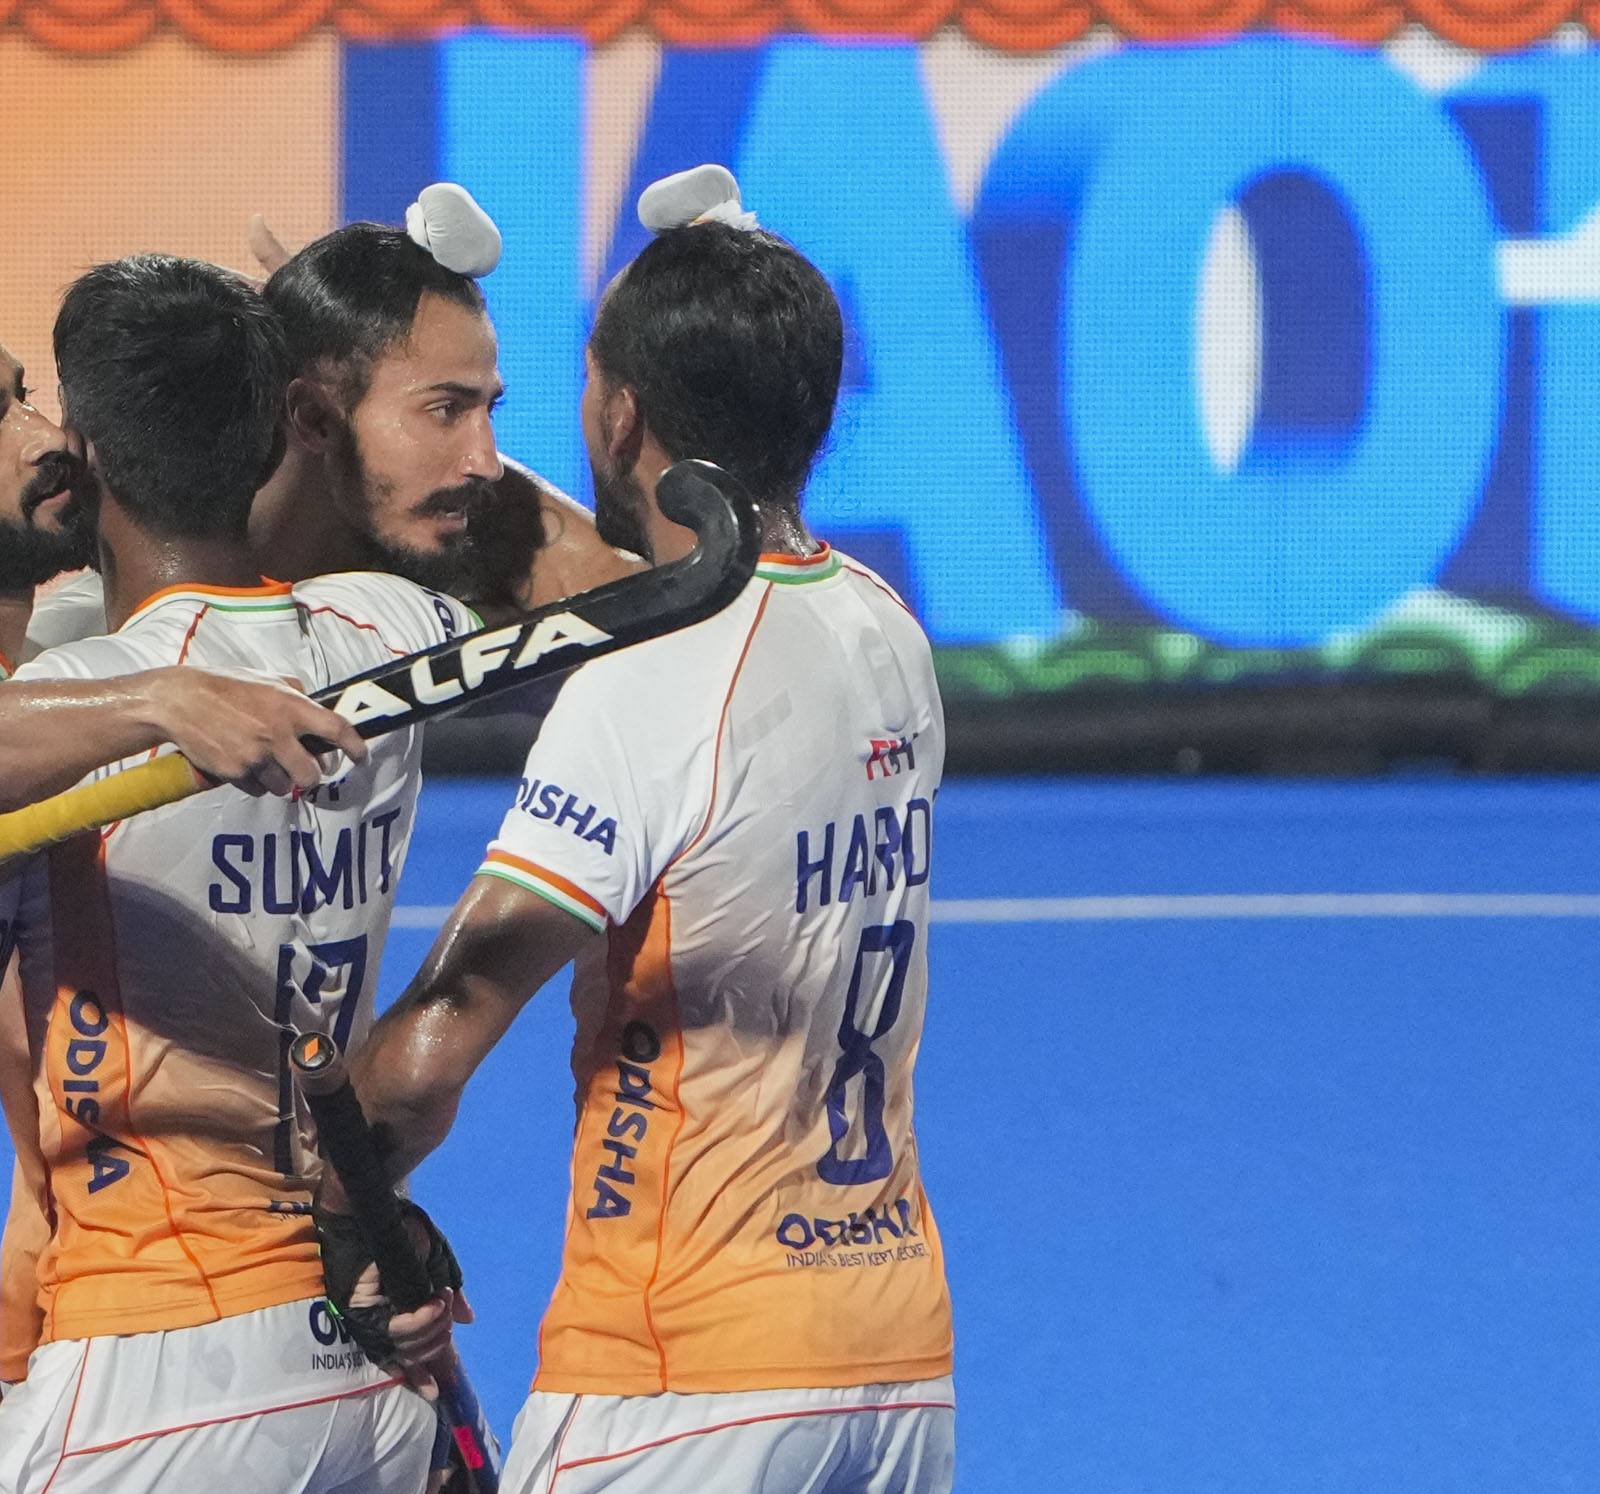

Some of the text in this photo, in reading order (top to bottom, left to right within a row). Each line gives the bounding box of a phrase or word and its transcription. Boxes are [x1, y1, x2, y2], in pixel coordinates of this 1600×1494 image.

[334, 611, 614, 726] ALFA
[209, 808, 401, 914] SUMIT
[518, 777, 617, 856] DISHA
[796, 797, 932, 914] HARD
[816, 919, 915, 1186] 8
[586, 1020, 660, 1219] ODISHA
[839, 1252, 865, 1267] BEST
[867, 1249, 893, 1266] KEPT
[896, 1243, 930, 1262] ECRE
